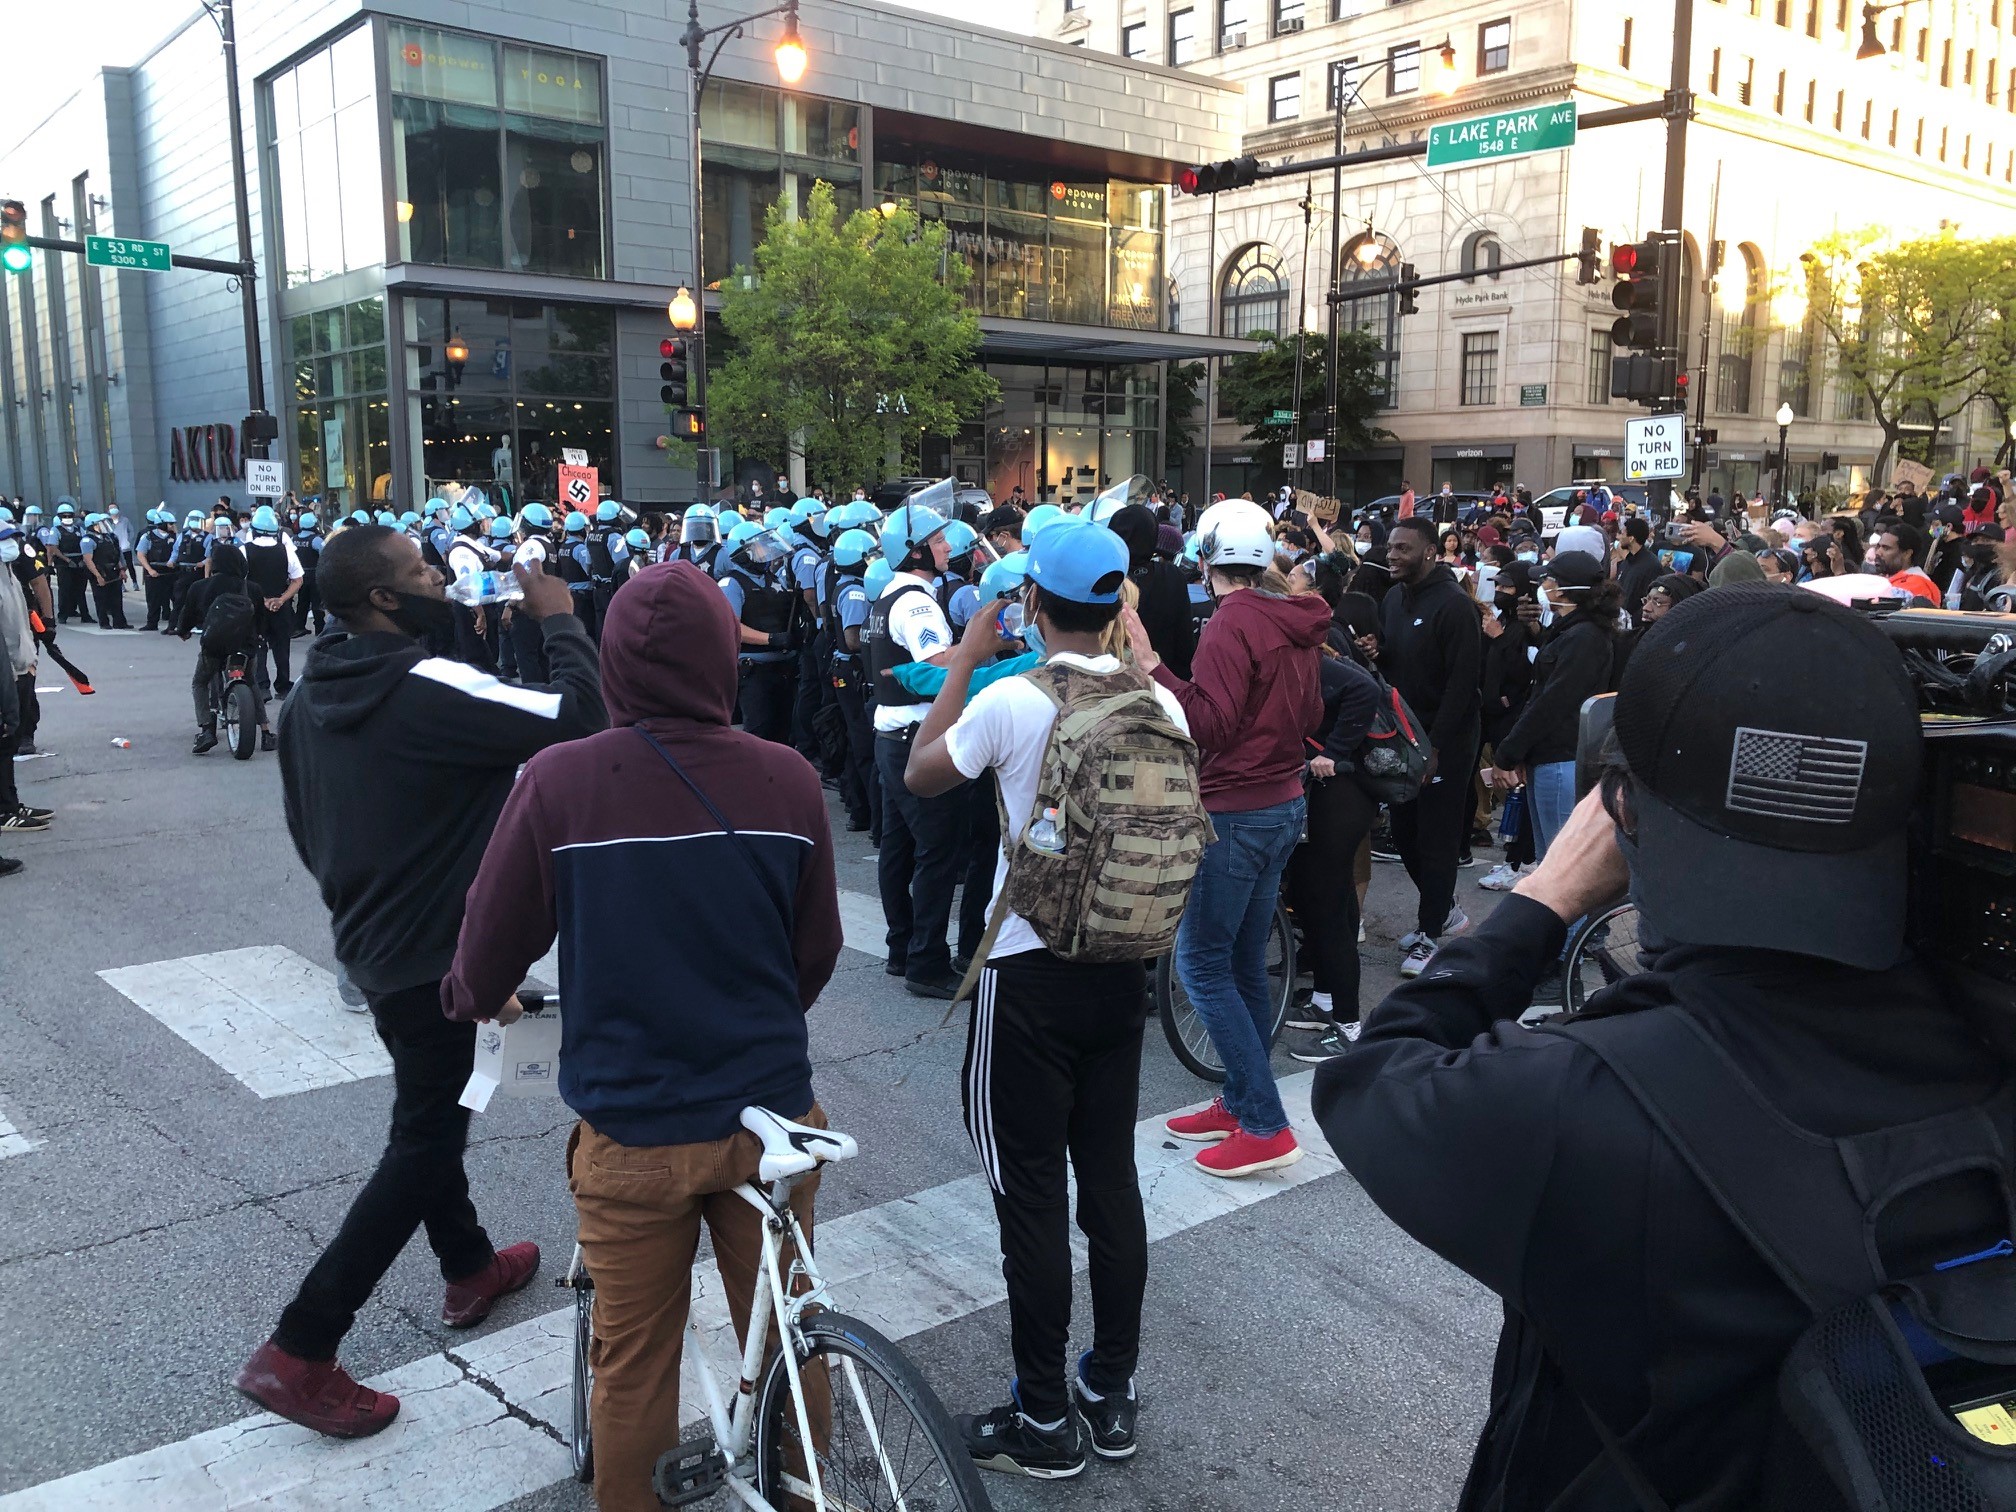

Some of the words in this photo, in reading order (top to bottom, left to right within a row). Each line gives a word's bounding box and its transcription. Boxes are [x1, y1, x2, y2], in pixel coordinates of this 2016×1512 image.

[521, 69, 582, 89] YOGA
[1432, 133, 1440, 145] S
[1449, 122, 1490, 144] LAKE
[1496, 113, 1539, 137] PARK
[1550, 110, 1573, 125] AVE
[1479, 140, 1504, 154] 1548
[1511, 137, 1519, 149] E
[920, 164, 983, 181] corepower
[938, 180, 968, 191] YOGA
[1050, 185, 1105, 202] corepower
[1064, 200, 1093, 210] YOGA
[92, 242, 99, 250] E
[108, 241, 126, 254] 53
[131, 243, 145, 253] RD
[153, 247, 164, 257] ST
[111, 255, 135, 265] 5300
[141, 258, 149, 266] S
[1455, 293, 1474, 305] Hyde
[1475, 292, 1490, 302] Park
[1491, 291, 1509, 301] Bank
[1111, 309, 1132, 320] FREE
[1644, 425, 1665, 437] NO
[1456, 448, 1483, 458] verizon
[1592, 448, 1610, 456] verizon
[1638, 440, 1672, 454] TURN
[1631, 459, 1648, 472] ON
[1655, 457, 1679, 470] RED
[255, 474, 277, 482] TURN
[250, 484, 261, 492] ON
[266, 485, 281, 493] RED
[588, 533, 604, 542] POLICE
